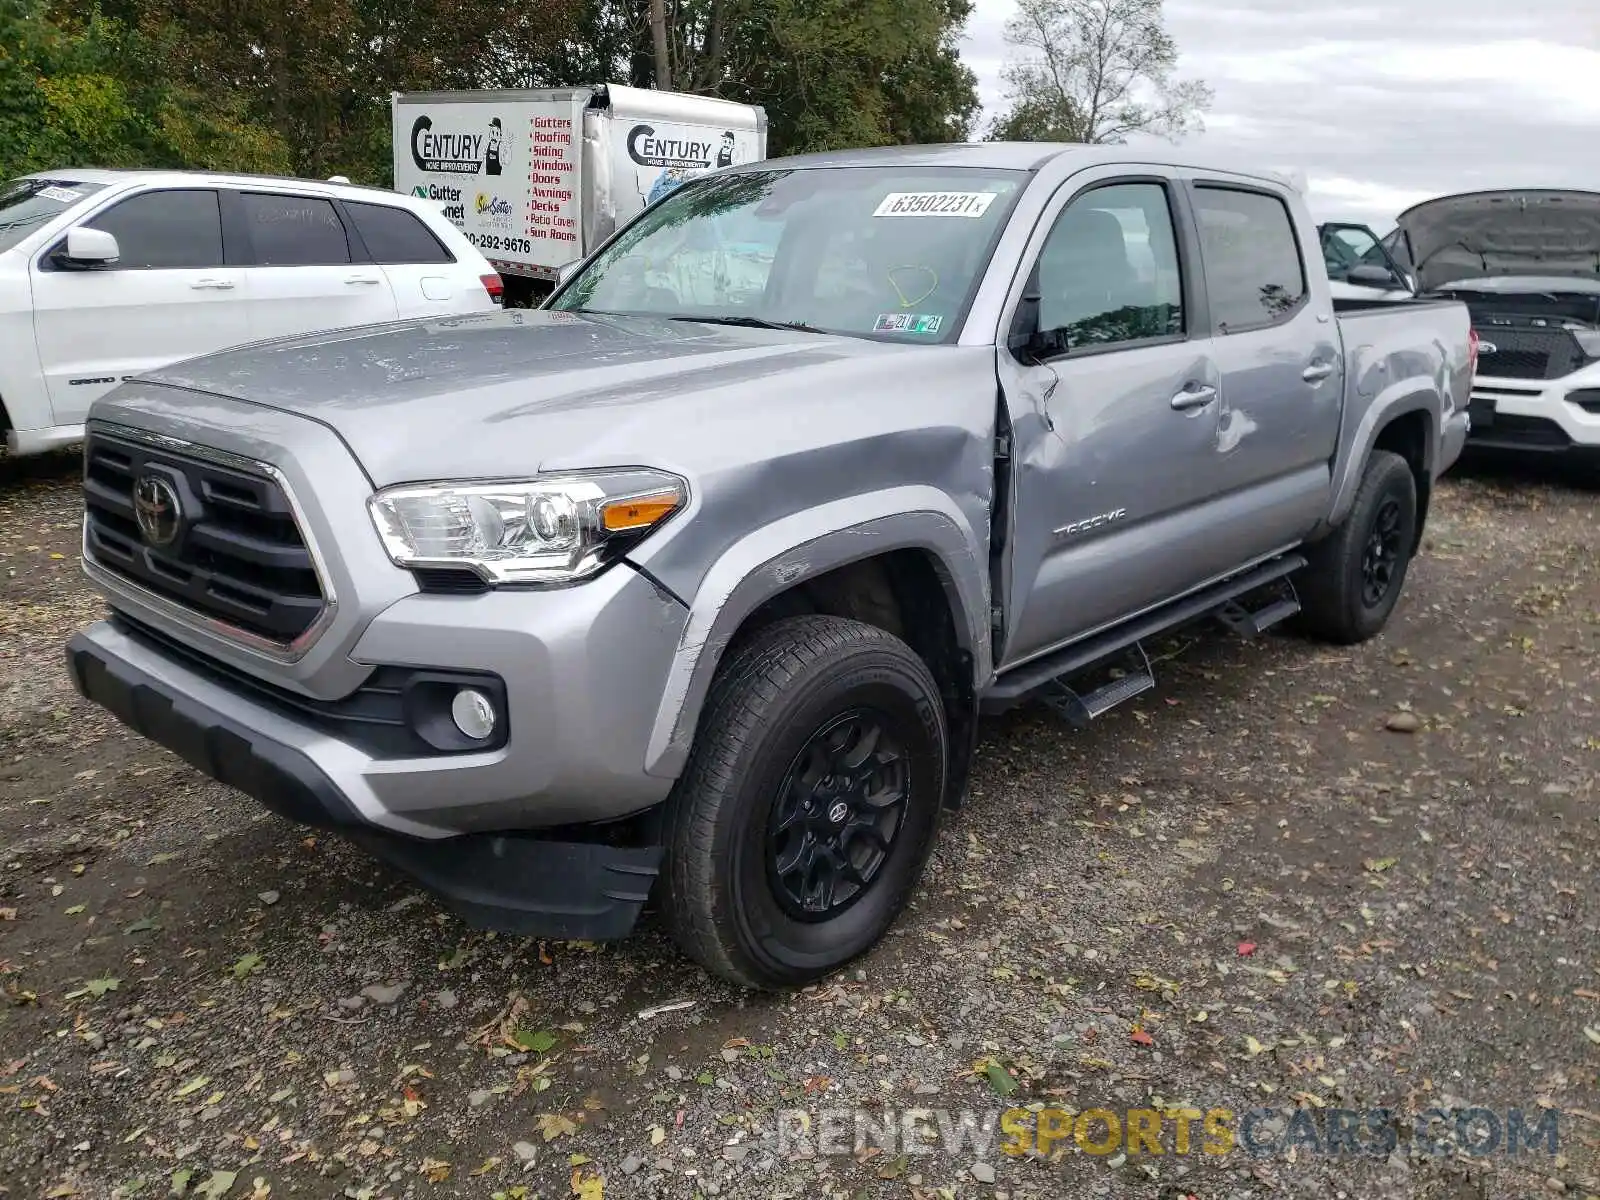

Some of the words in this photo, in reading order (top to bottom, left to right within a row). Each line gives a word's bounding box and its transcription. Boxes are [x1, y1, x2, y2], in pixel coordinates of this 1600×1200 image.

[534, 117, 571, 128] Gutters
[411, 115, 482, 168] CENTURY
[534, 131, 571, 145] Roofing
[626, 125, 711, 164] CENTURY
[533, 146, 564, 159] Siding
[425, 161, 440, 170] HOME
[441, 162, 478, 172] IMPROVEMENTS
[533, 159, 574, 172] Window
[648, 158, 664, 166] HOME
[532, 172, 561, 184] Doors
[429, 184, 461, 200] Gutter
[532, 186, 572, 201] Awnings
[477, 195, 513, 215] SunSetter
[531, 200, 560, 212] Decks
[891, 195, 978, 212] 63502231
[443, 204, 465, 219] met
[530, 213, 551, 225] Patio
[553, 215, 576, 228] Cover
[530, 227, 547, 239] Sun
[464, 233, 531, 253] 0-292-9676
